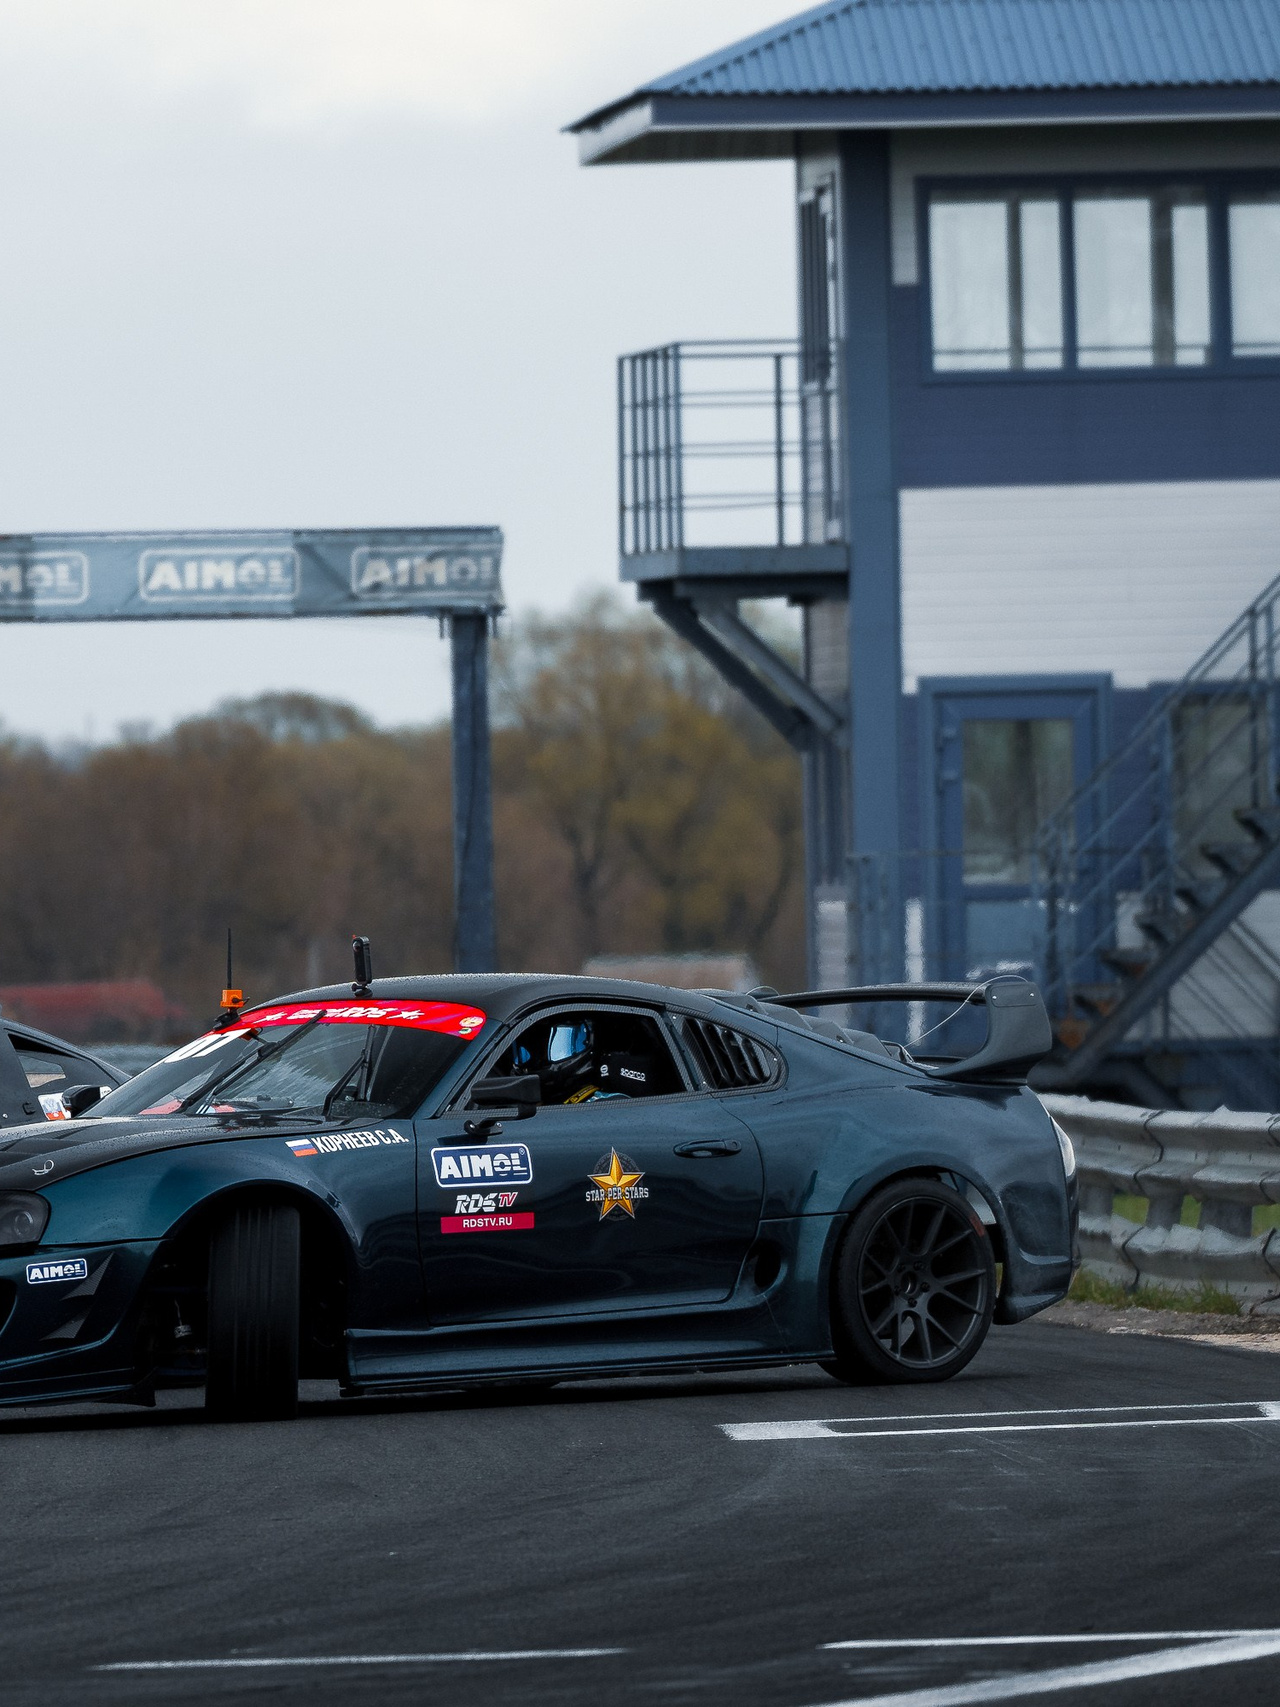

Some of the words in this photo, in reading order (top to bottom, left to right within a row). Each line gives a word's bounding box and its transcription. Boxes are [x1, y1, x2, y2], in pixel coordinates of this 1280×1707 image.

[140, 561, 294, 592] AIMOL
[620, 1067, 646, 1081] sparco
[311, 1131, 380, 1154] КОРНЕЕВ
[440, 1153, 528, 1179] AIMOL
[585, 1188, 606, 1202] STAR
[624, 1186, 649, 1199] STARS
[462, 1216, 513, 1228] RDSTV.RU
[30, 1263, 85, 1280] AIMOL
